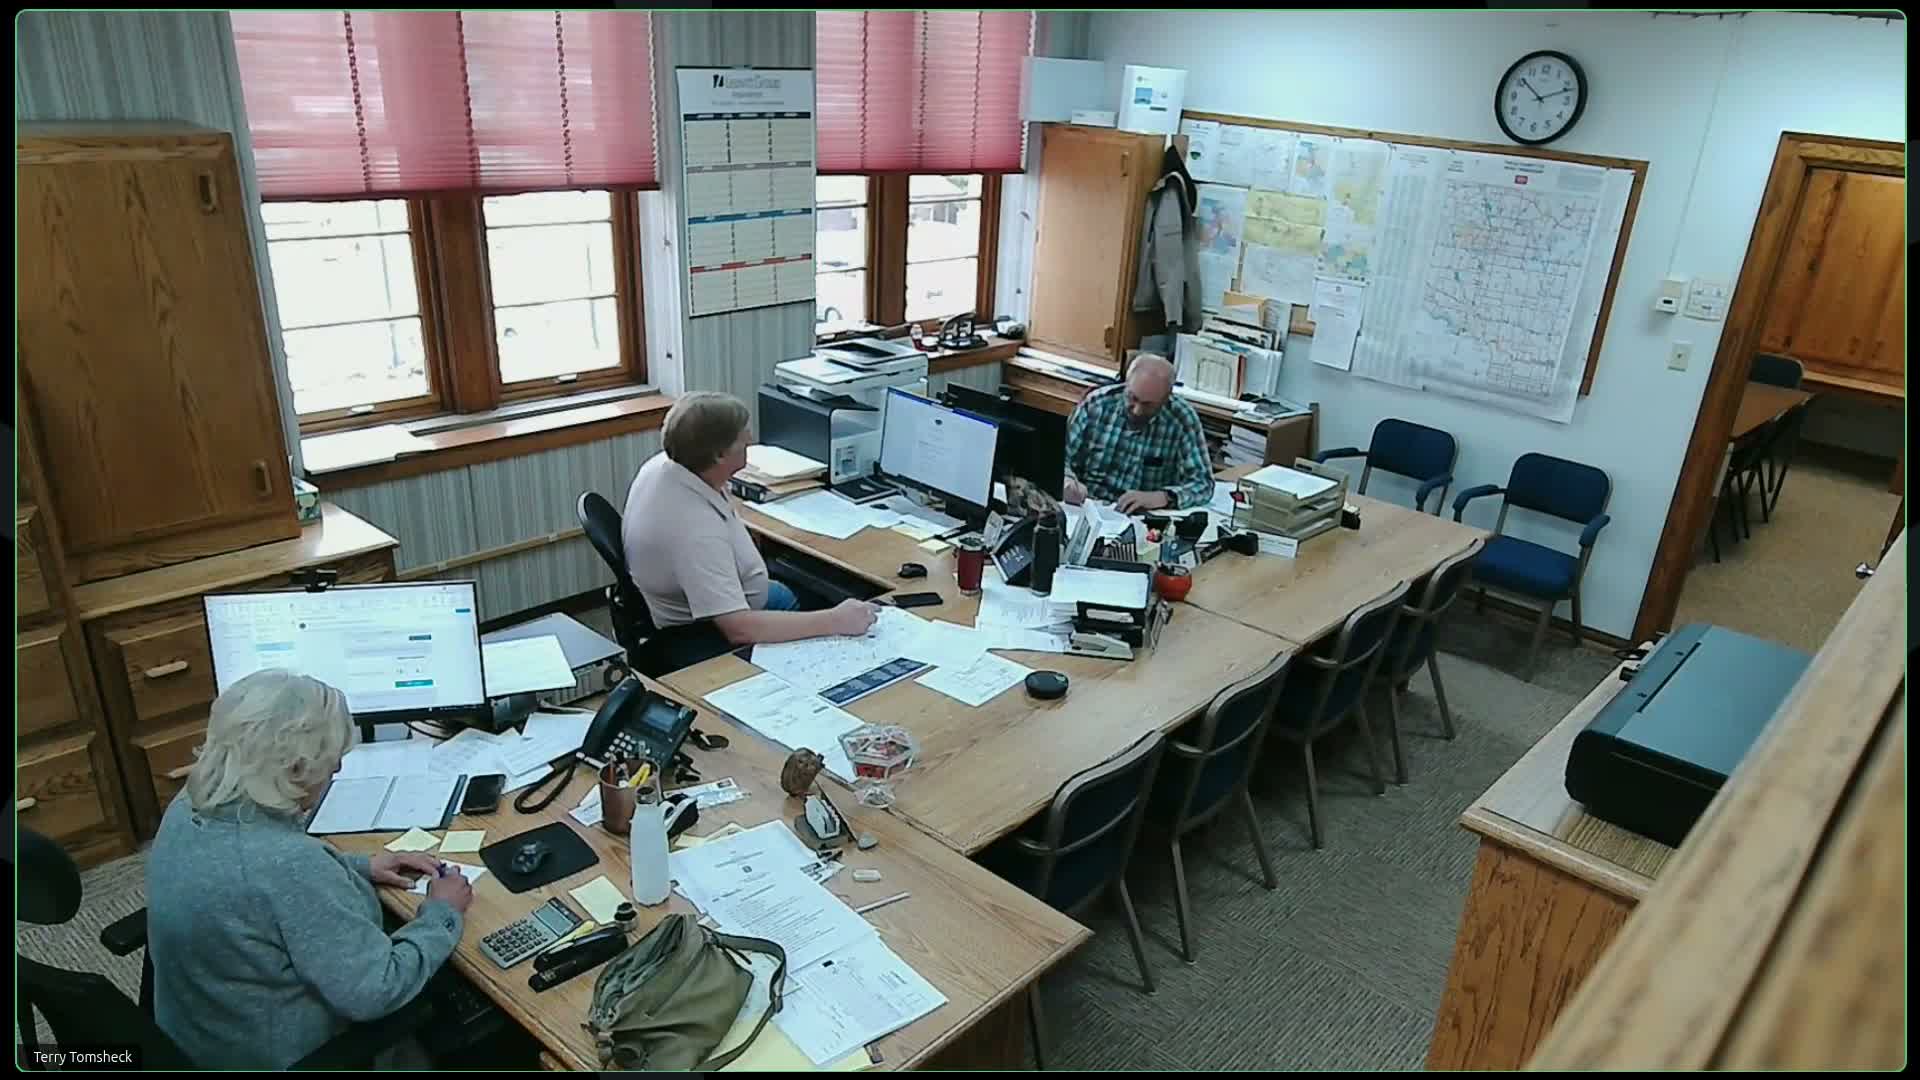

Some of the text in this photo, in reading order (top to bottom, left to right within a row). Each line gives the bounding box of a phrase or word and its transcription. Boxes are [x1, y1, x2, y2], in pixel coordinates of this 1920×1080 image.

[1562, 96, 1570, 106] 3
[1519, 116, 1525, 126] 7
[1544, 120, 1551, 130] 5
[1530, 122, 1537, 132] 6
